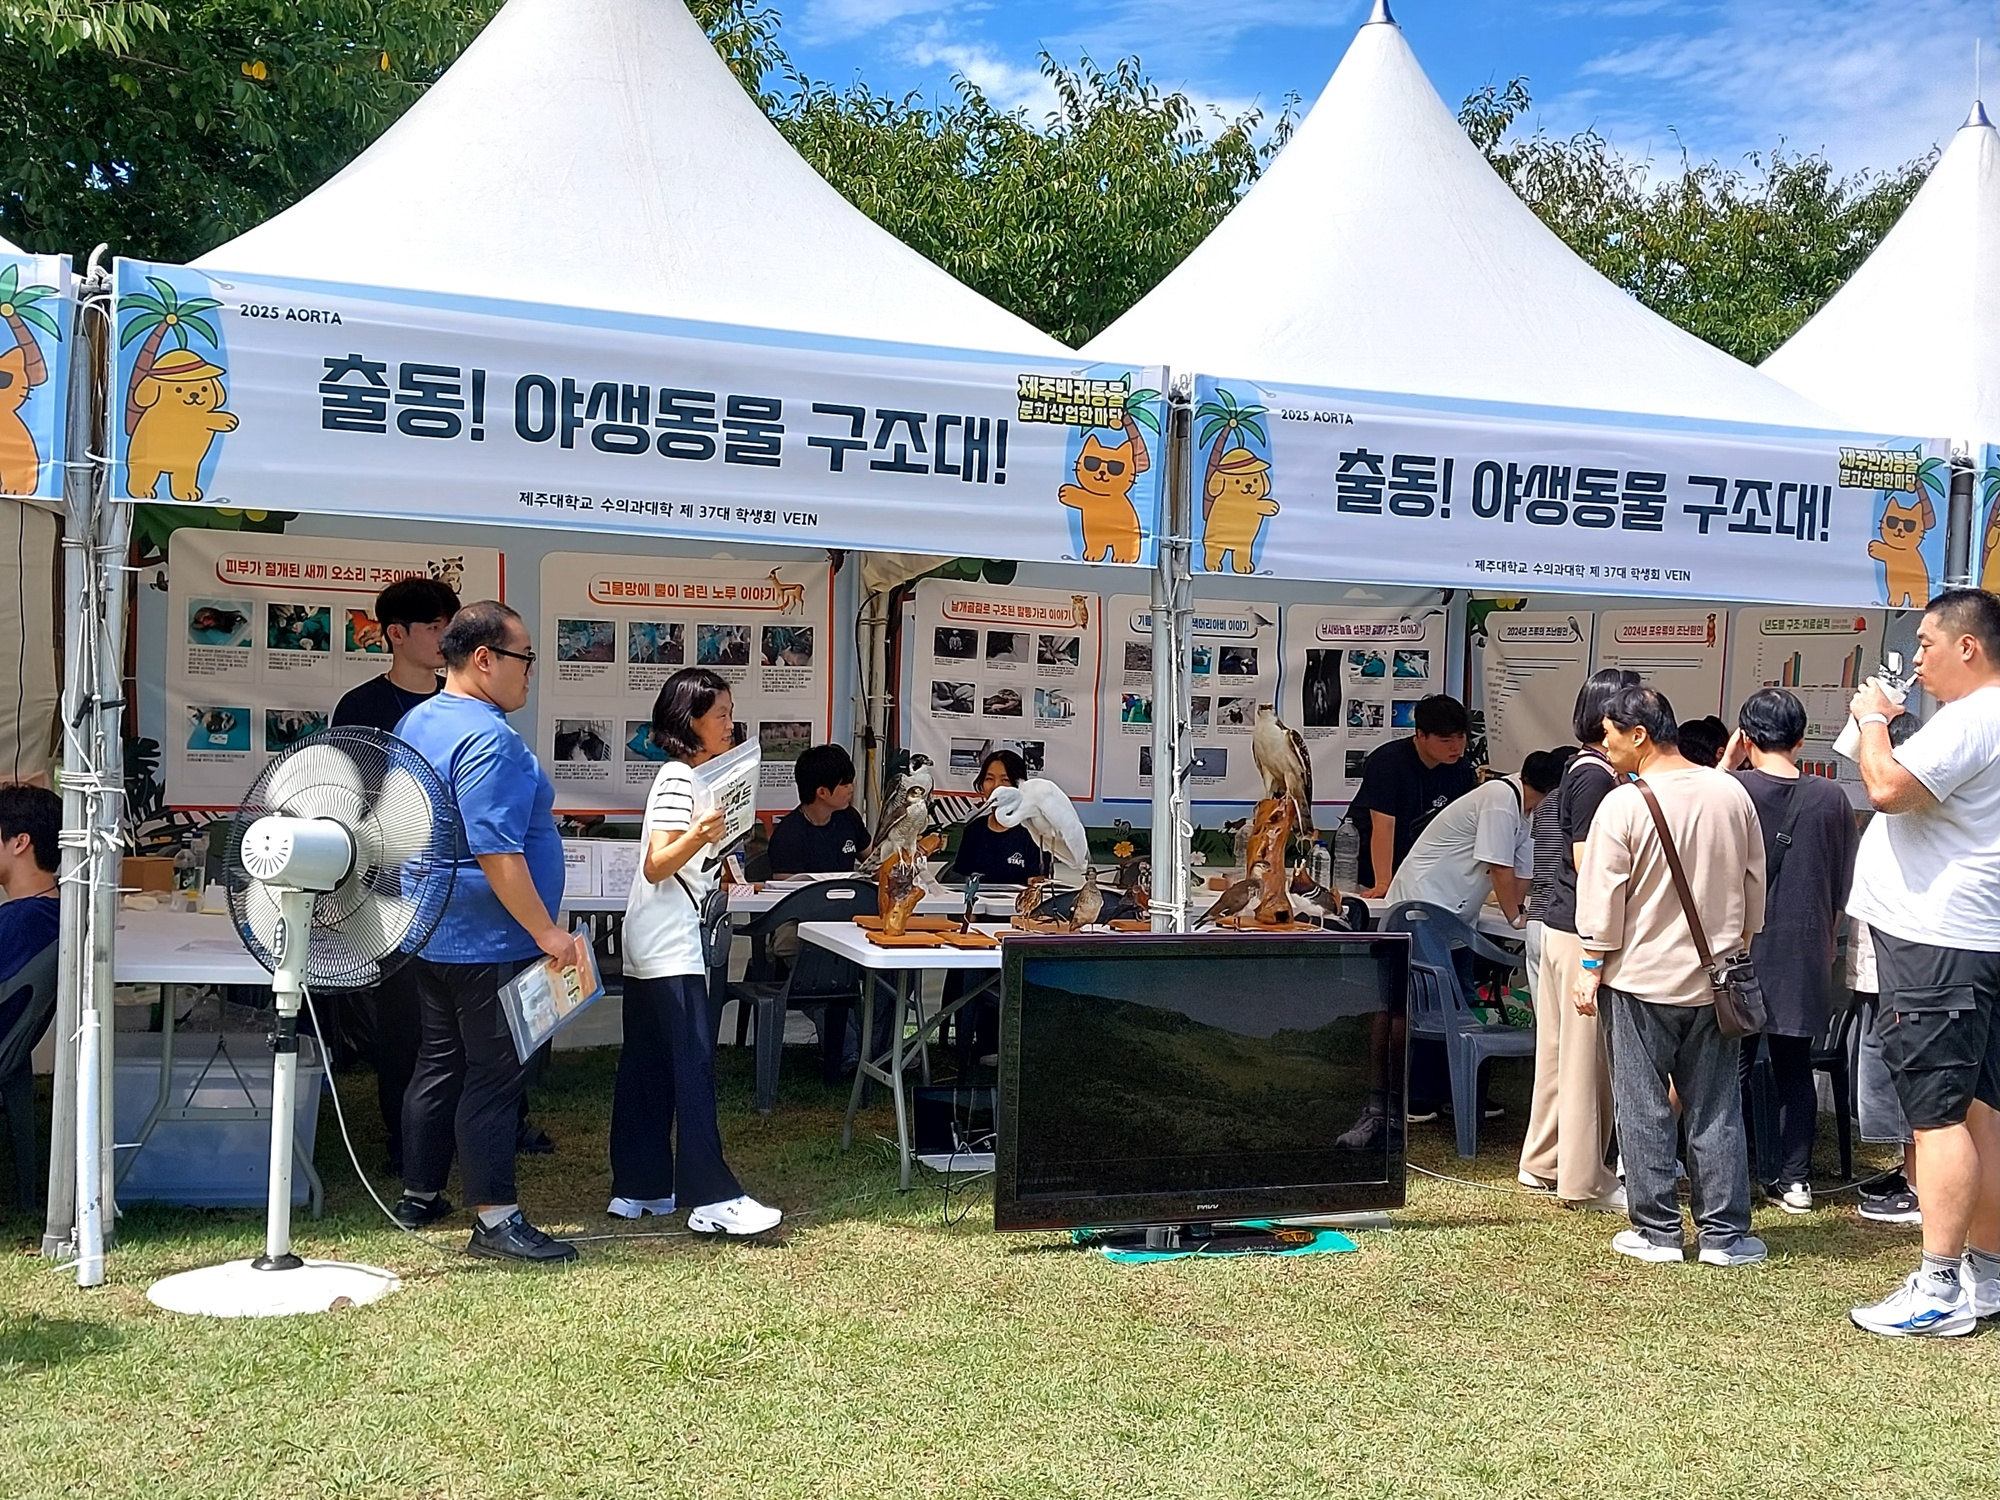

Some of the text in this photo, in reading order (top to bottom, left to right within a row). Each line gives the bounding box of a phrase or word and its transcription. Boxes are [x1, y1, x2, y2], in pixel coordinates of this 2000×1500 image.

[240, 304, 342, 326] 2025 AORTA
[1018, 374, 1127, 408] 제주반려동물
[318, 353, 1008, 486] 출동! 야생동물 구조대!
[1018, 400, 1123, 430] 문화산업한마당
[1281, 408, 1354, 425] 2025 AORTA
[1840, 447, 1921, 474] 제주반려동물
[1839, 468, 1917, 493] 문화산업한마당
[1335, 447, 1833, 542] 출동! 야생동물 구조대!
[519, 490, 819, 527] 제주대학교 수의과대학 제 37대 학생회 VEIN
[226, 558, 261, 576] 피부가
[265, 561, 300, 579] 절개된
[304, 564, 328, 580] 새끼
[331, 565, 366, 582] 오소리
[1475, 559, 1691, 582] 제주대학교 수의과대학 제 37대 학생회 VEIN
[598, 580, 776, 602] 그물망에 뿔이 걸린 노루 이야기
[993, 603, 1015, 617] 구조된
[1049, 608, 1071, 621] 이야기
[1191, 617, 1226, 631] 색머리아비
[1228, 619, 1249, 632] 이야기
[1387, 624, 1400, 636] 구조
[1400, 624, 1419, 636] 이야기
[1507, 626, 1568, 637] 2024년 조류의 조난원인
[1623, 624, 1704, 637] 2024년 포유류의 조난원인
[1764, 619, 1785, 630] 년도별
[1807, 723, 1821, 735] 실적
